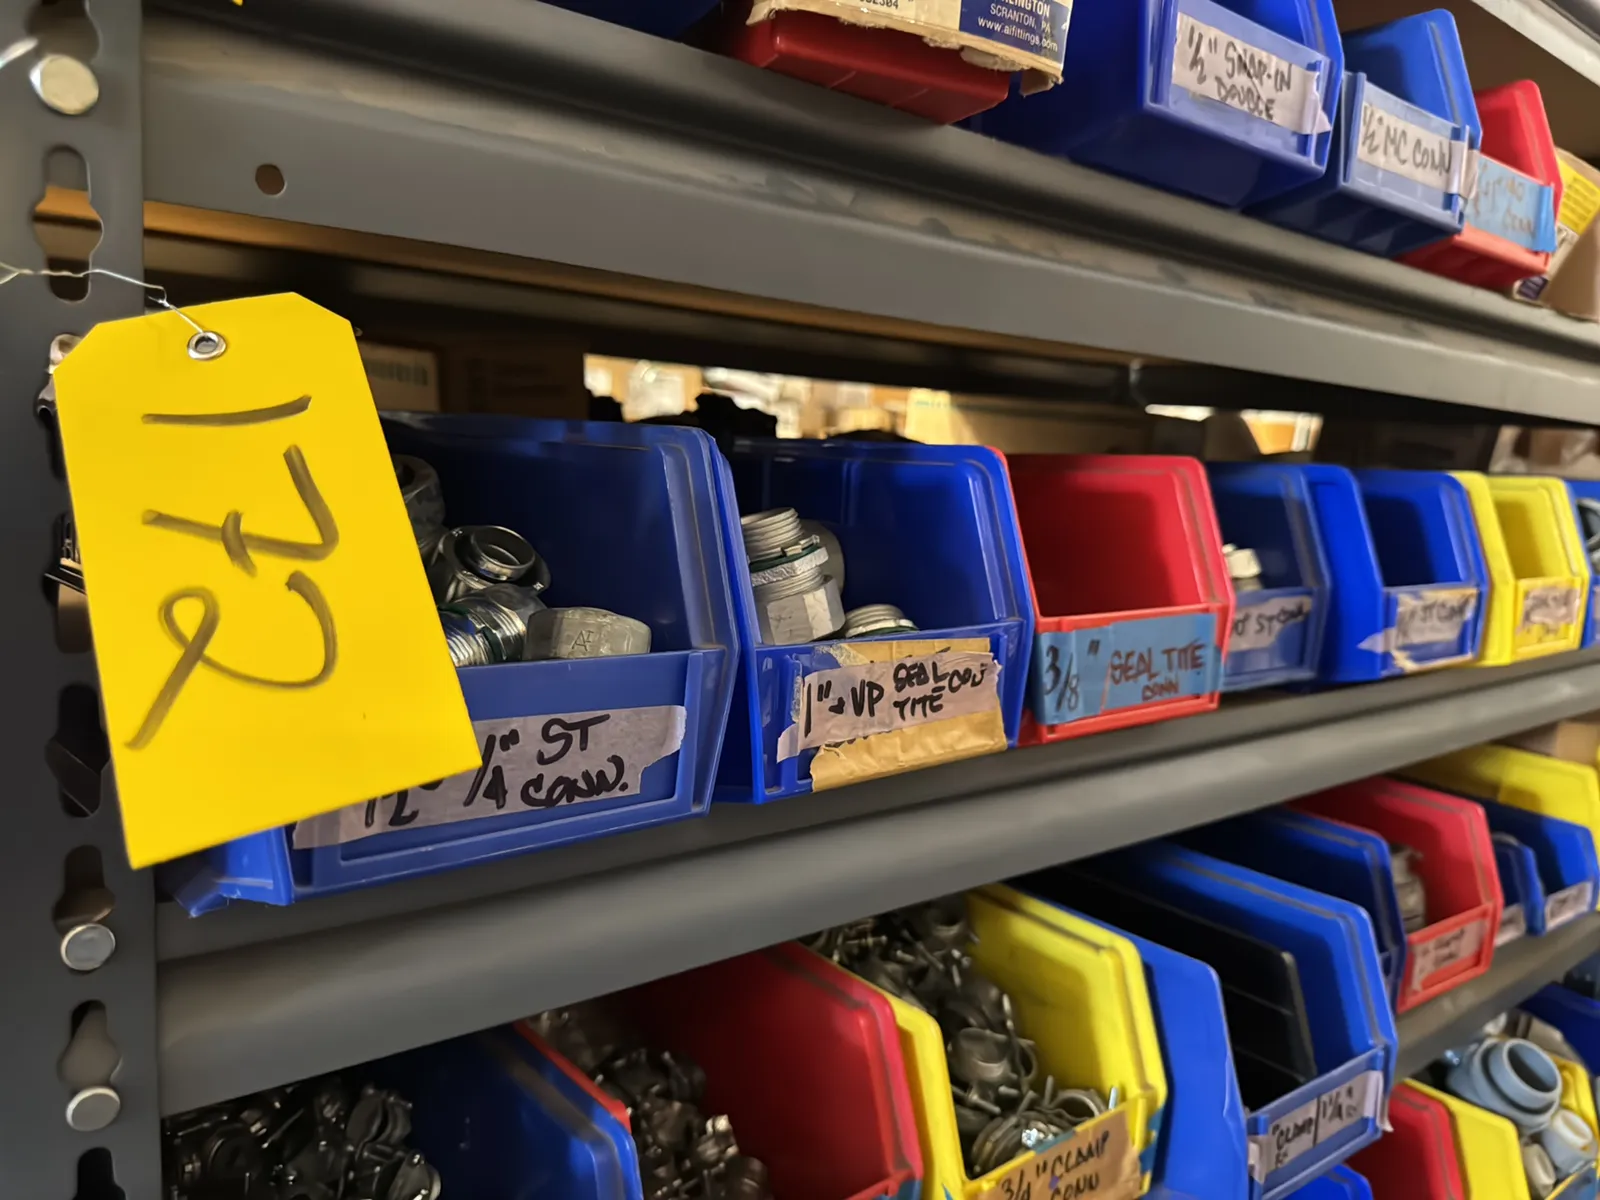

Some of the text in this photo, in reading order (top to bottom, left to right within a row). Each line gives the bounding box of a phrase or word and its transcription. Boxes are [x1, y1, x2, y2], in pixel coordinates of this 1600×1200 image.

[978, 16, 1058, 52] www.aifittings.com
[990, 3, 1051, 33] SCRANTON, PA
[1110, 646, 1160, 686] SEAL
[536, 713, 611, 766] ST
